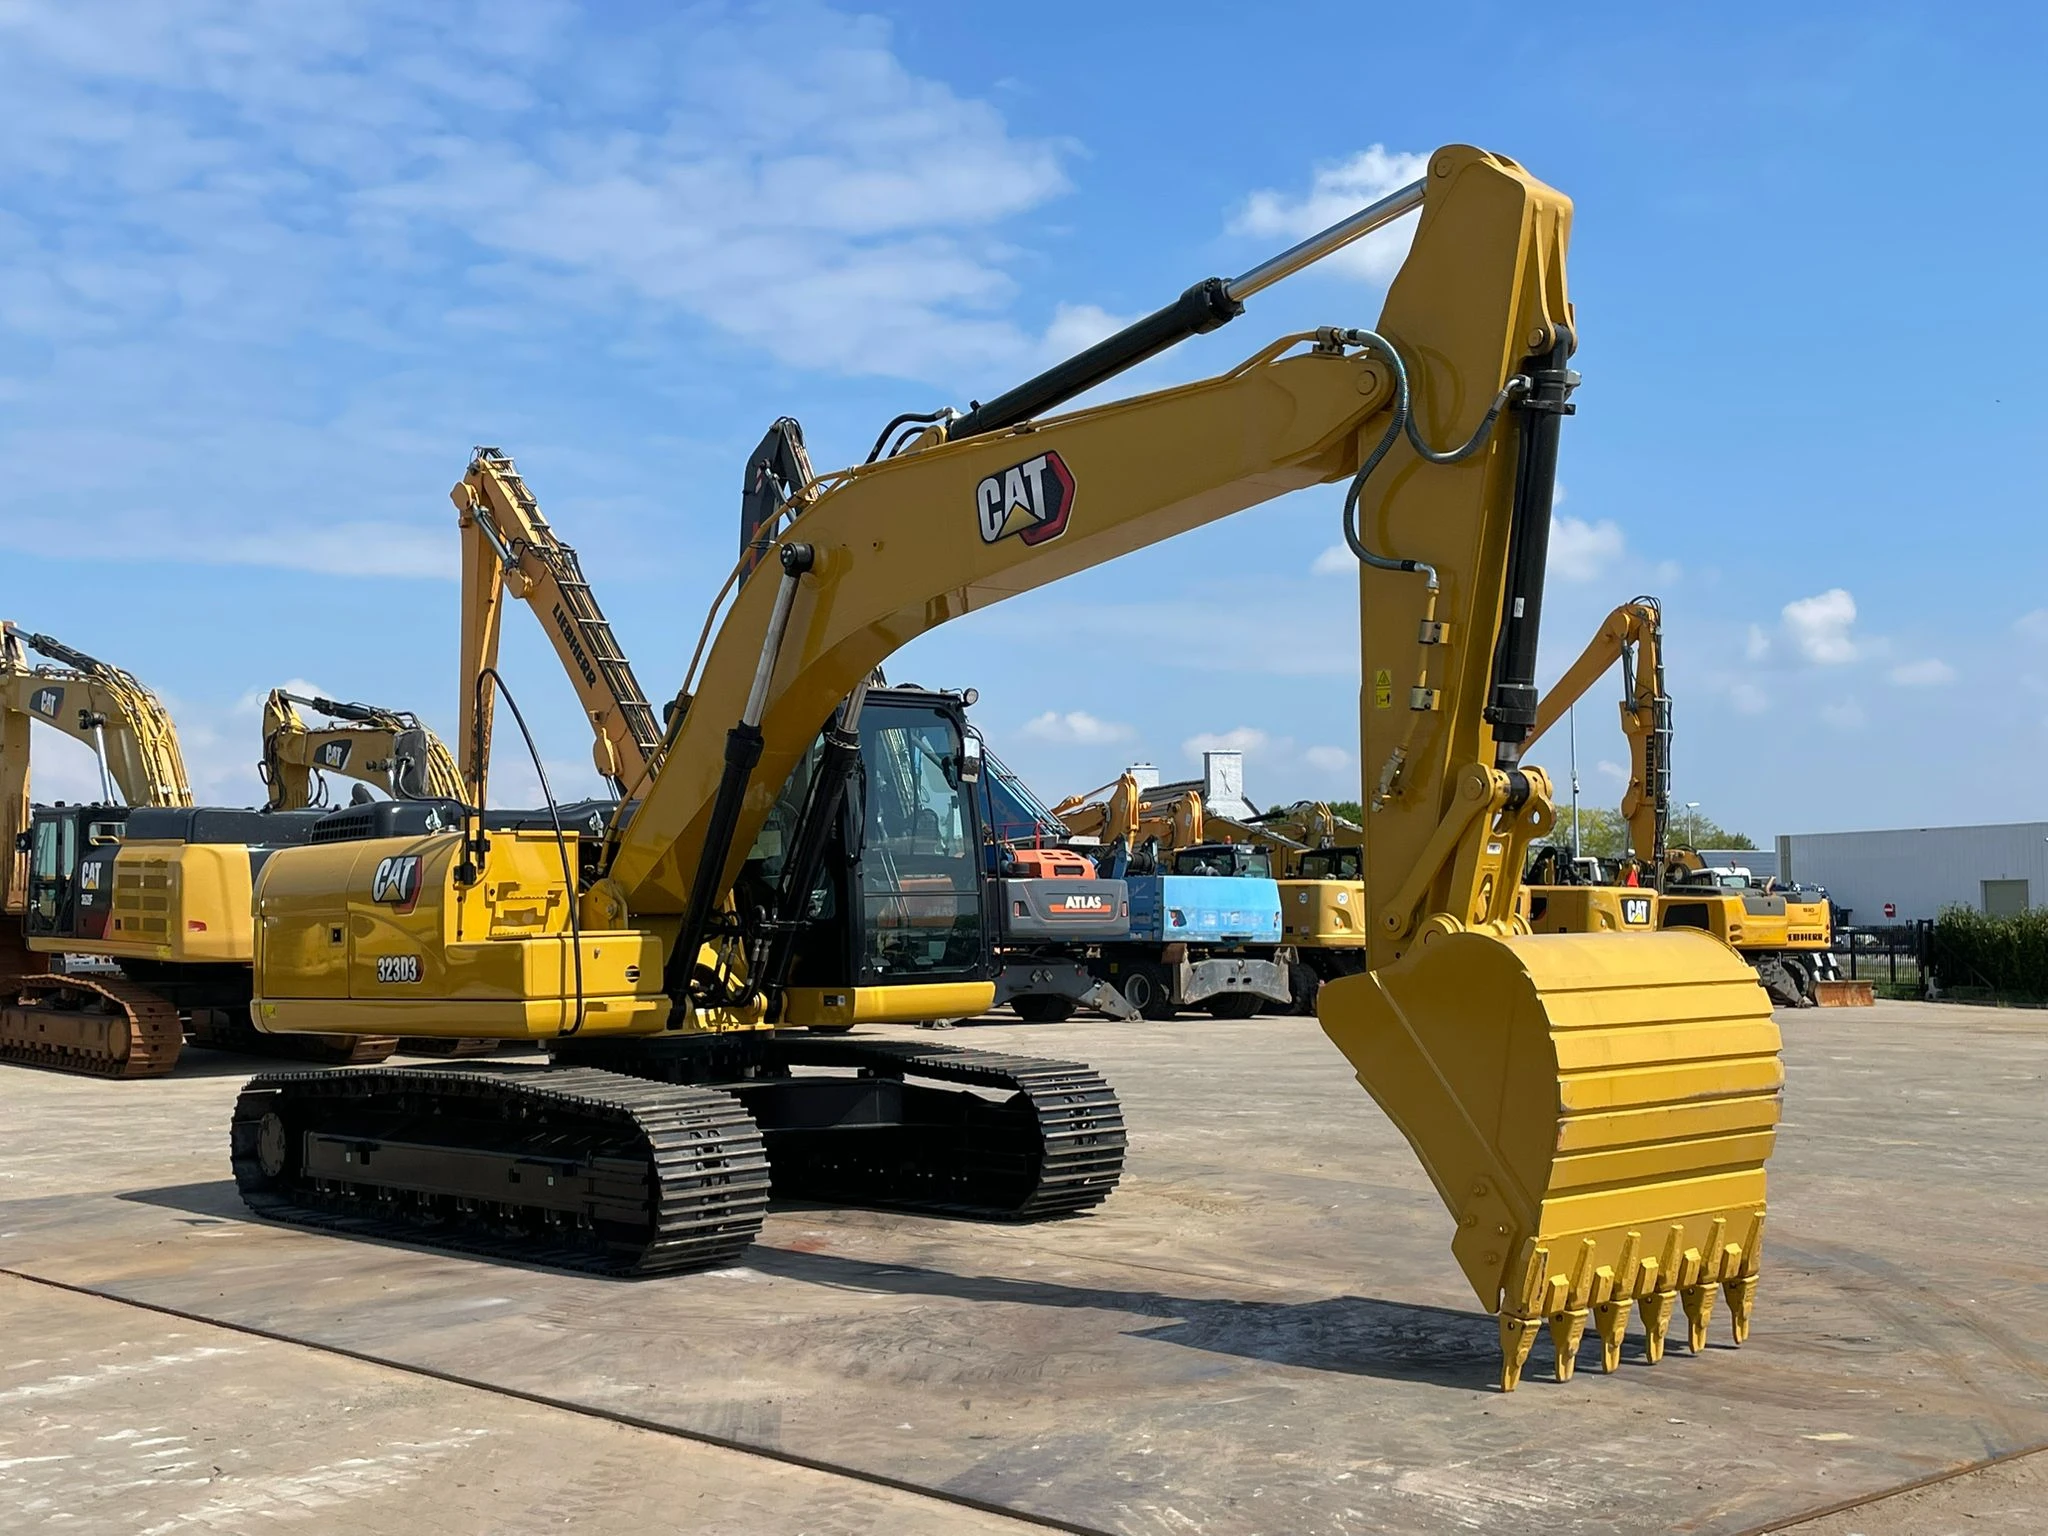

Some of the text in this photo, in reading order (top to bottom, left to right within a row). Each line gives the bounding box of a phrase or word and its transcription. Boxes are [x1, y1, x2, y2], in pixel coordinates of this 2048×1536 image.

[978, 455, 1047, 542] CAT
[552, 602, 597, 690] LIEBHERR
[41, 690, 56, 716] CAT
[326, 744, 343, 767] CAT
[1645, 734, 1655, 797] LIEBHERR
[82, 861, 102, 889] CAT
[373, 857, 418, 902] CAT
[1065, 896, 1102, 909] ATLAS
[1627, 900, 1648, 923] CAT
[1787, 933, 1823, 942] EBHERR
[377, 955, 418, 982] 323D3
